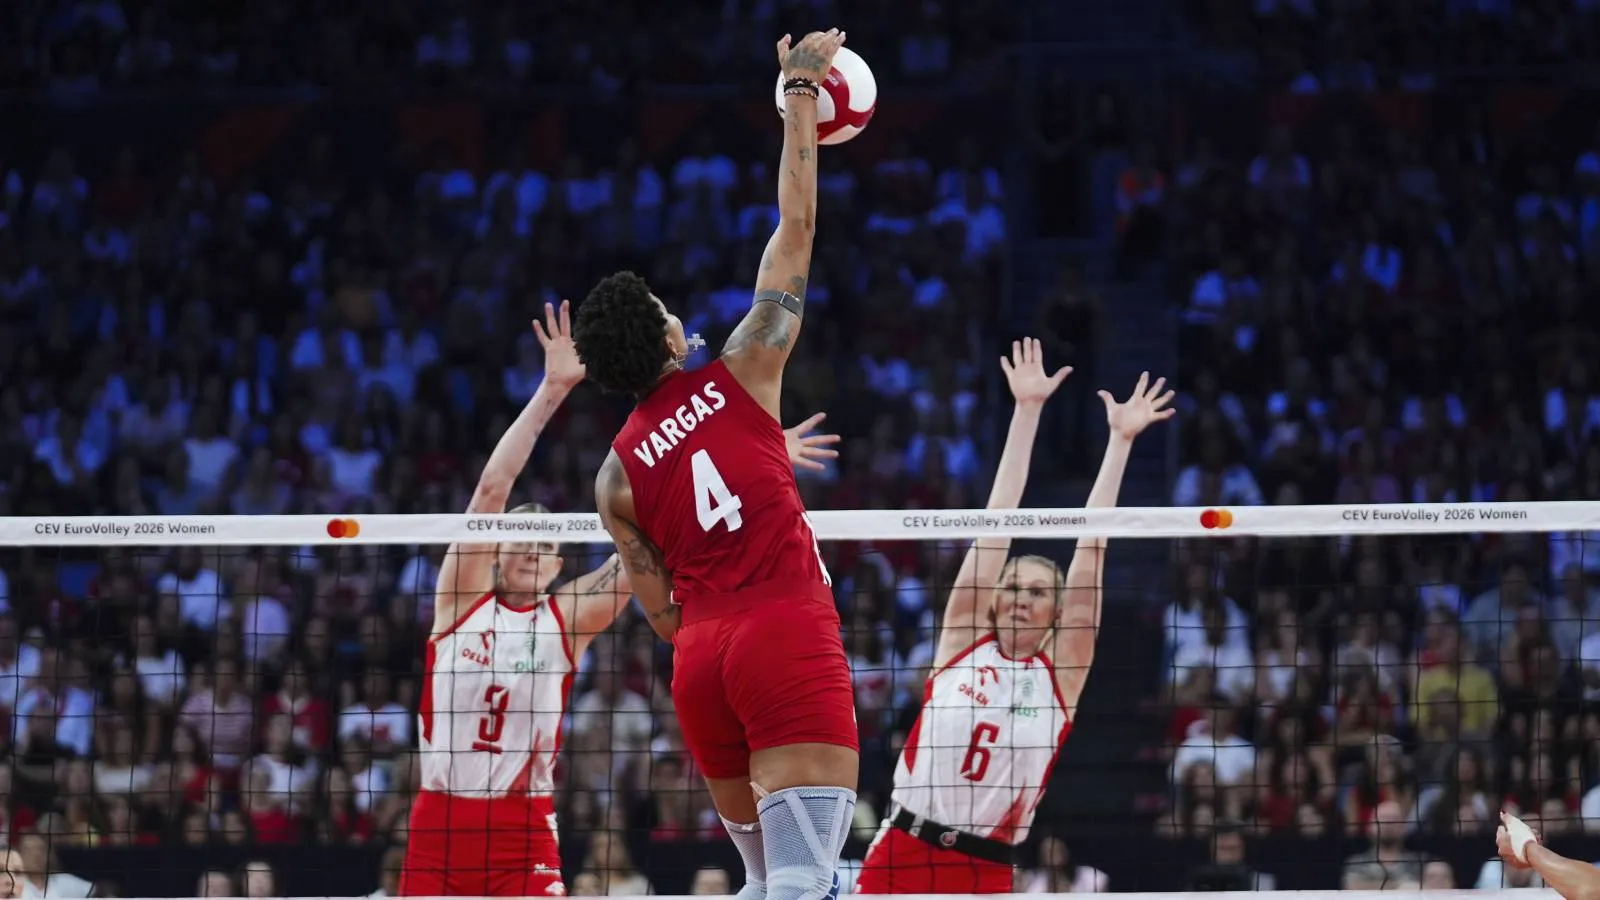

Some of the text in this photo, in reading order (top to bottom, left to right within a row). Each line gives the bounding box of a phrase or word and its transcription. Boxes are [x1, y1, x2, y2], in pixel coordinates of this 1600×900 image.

[634, 381, 726, 468] VARGAS
[691, 448, 743, 533] 4
[34, 522, 216, 537] CEV EuroVolley 2026 Women
[466, 519, 598, 533] CEV EuroVolley 2026
[902, 513, 1087, 529] CEV EuroVolley 2026 Women
[1342, 509, 1528, 523] CEV EuroVolley 2026 Women
[477, 686, 509, 743] 3
[960, 721, 1000, 782] 6
